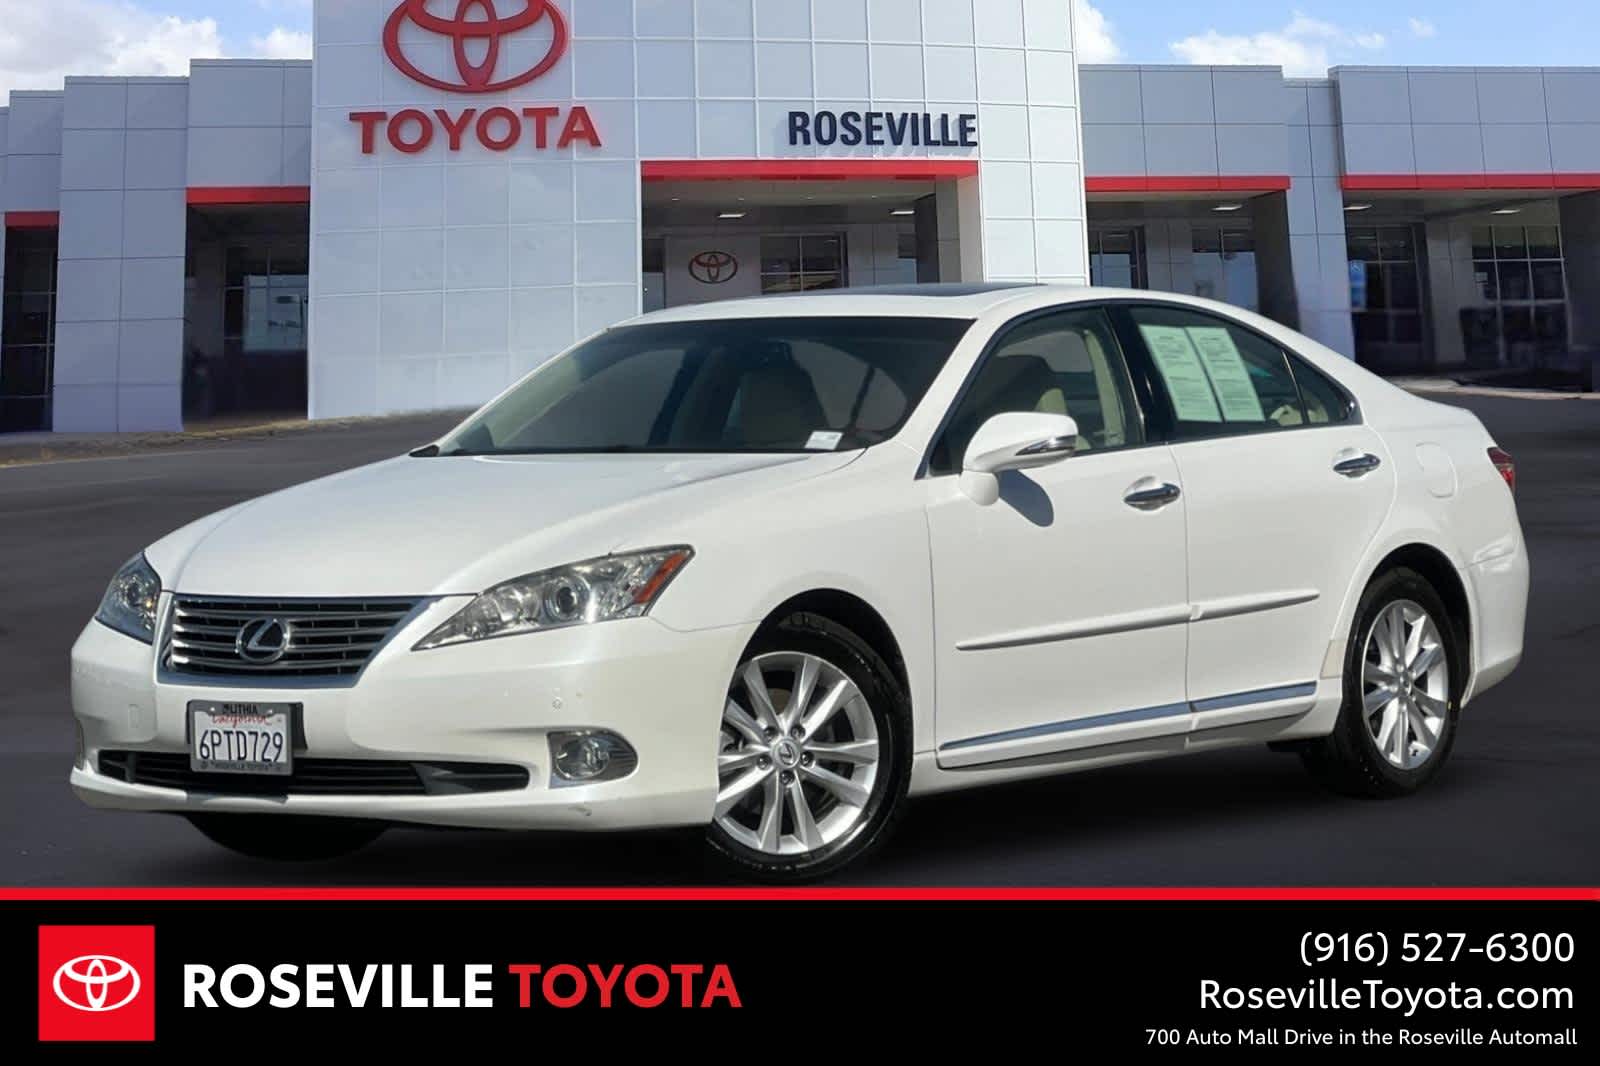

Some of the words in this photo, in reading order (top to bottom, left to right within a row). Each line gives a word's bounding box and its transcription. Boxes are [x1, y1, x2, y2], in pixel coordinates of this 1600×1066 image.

[349, 106, 602, 154] TOYOTA
[788, 110, 978, 148] ROSEVILLE
[199, 729, 283, 763] 6PTD729
